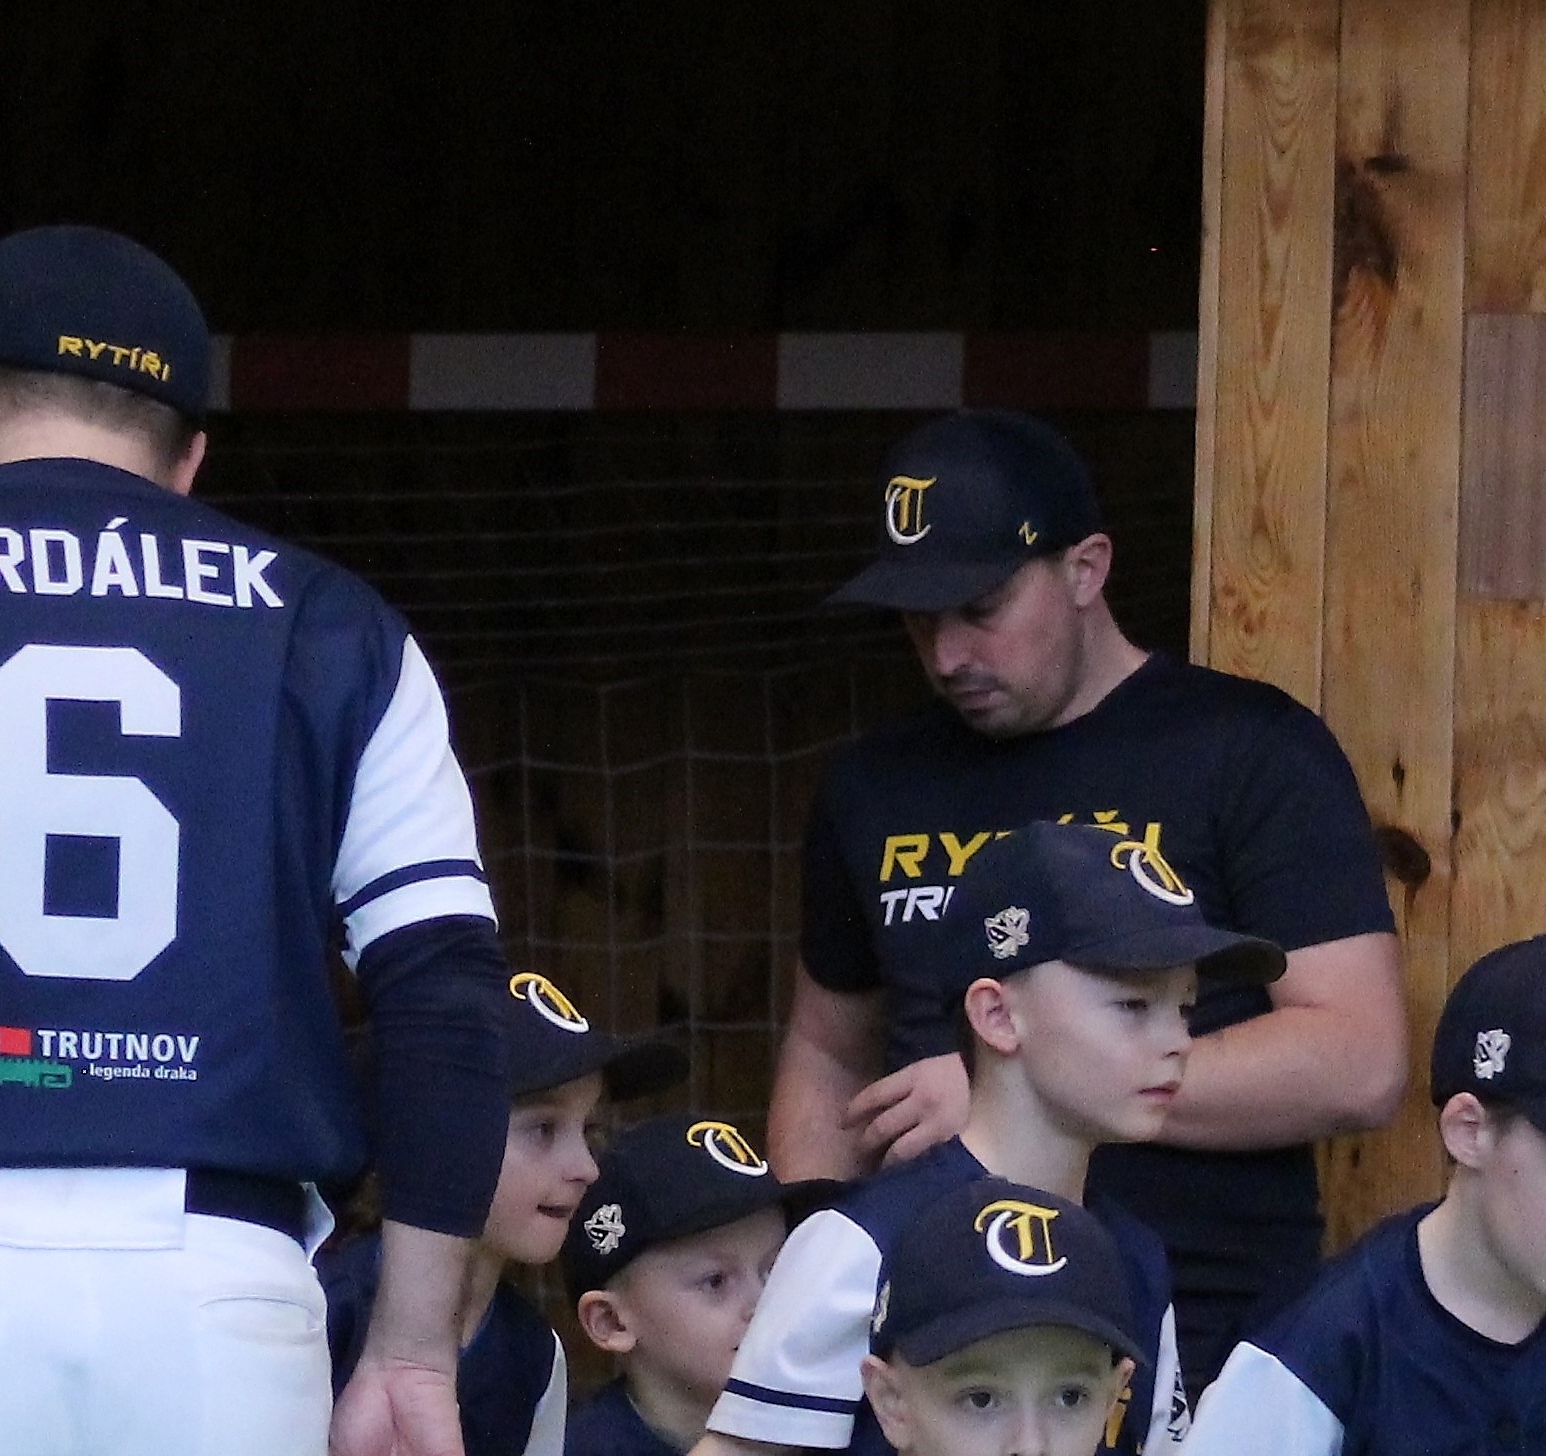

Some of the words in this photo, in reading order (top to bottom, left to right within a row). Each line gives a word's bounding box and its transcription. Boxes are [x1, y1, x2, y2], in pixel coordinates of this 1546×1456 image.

[37, 1029, 200, 1063] TRUTNOV
[89, 1063, 151, 1081] legenda
[154, 1065, 198, 1081] draka
